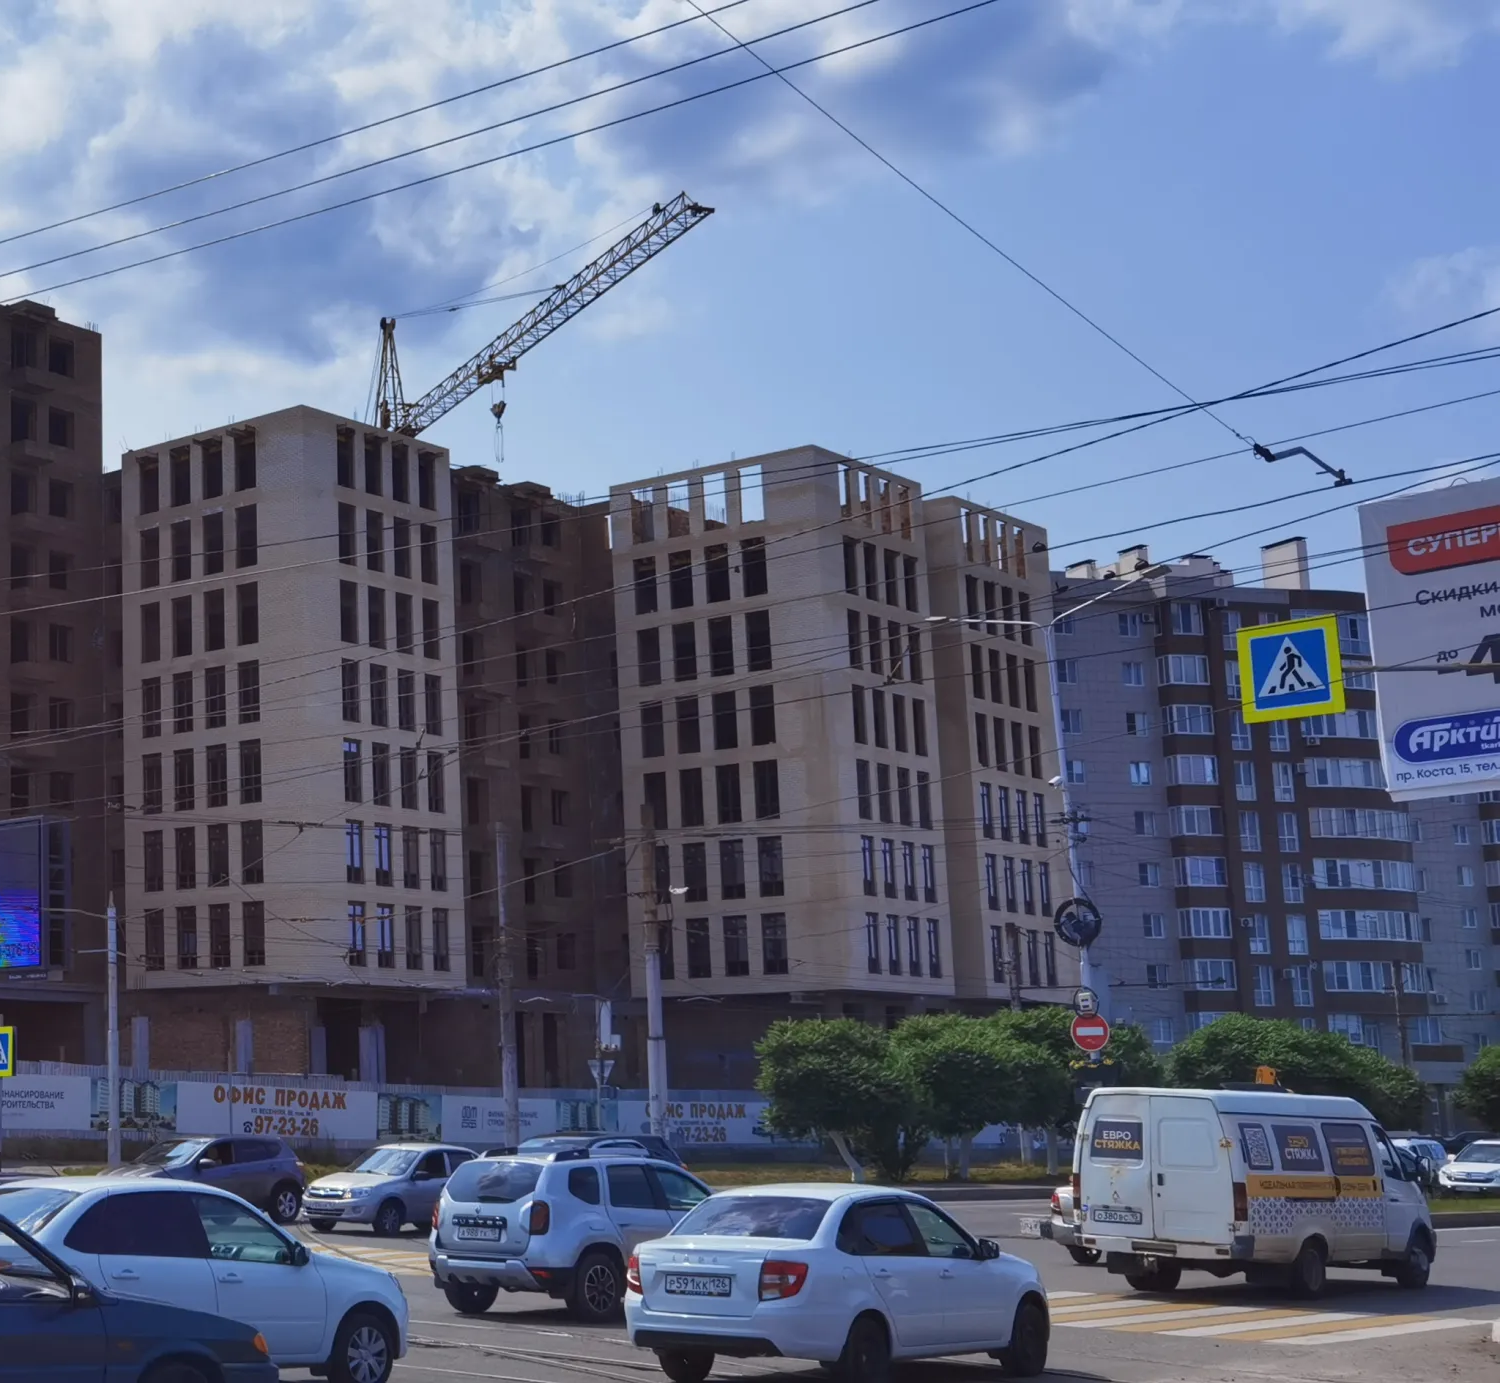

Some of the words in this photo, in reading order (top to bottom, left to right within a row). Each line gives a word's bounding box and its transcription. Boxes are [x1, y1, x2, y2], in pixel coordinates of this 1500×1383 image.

[1408, 523, 1500, 556] СУПЕР
[1415, 581, 1498, 605] Скидки
[1480, 605, 1500, 618] м
[1437, 650, 1458, 663] до
[1396, 771, 1415, 783] пр.
[1416, 766, 1457, 779] Коста,
[1459, 763, 1473, 774] 15,
[213, 1085, 266, 1105] ОФИС
[274, 1088, 347, 1111] ПРОДАЖ
[644, 1102, 684, 1118] ОИС
[690, 1103, 747, 1120] ПРОДАЖ
[254, 1115, 319, 1136] 97-23-26
[1102, 1130, 1132, 1141] ЕВРО
[1094, 1139, 1141, 1151] СТЯЖКА
[1284, 1147, 1319, 1160] СТЯЖКА
